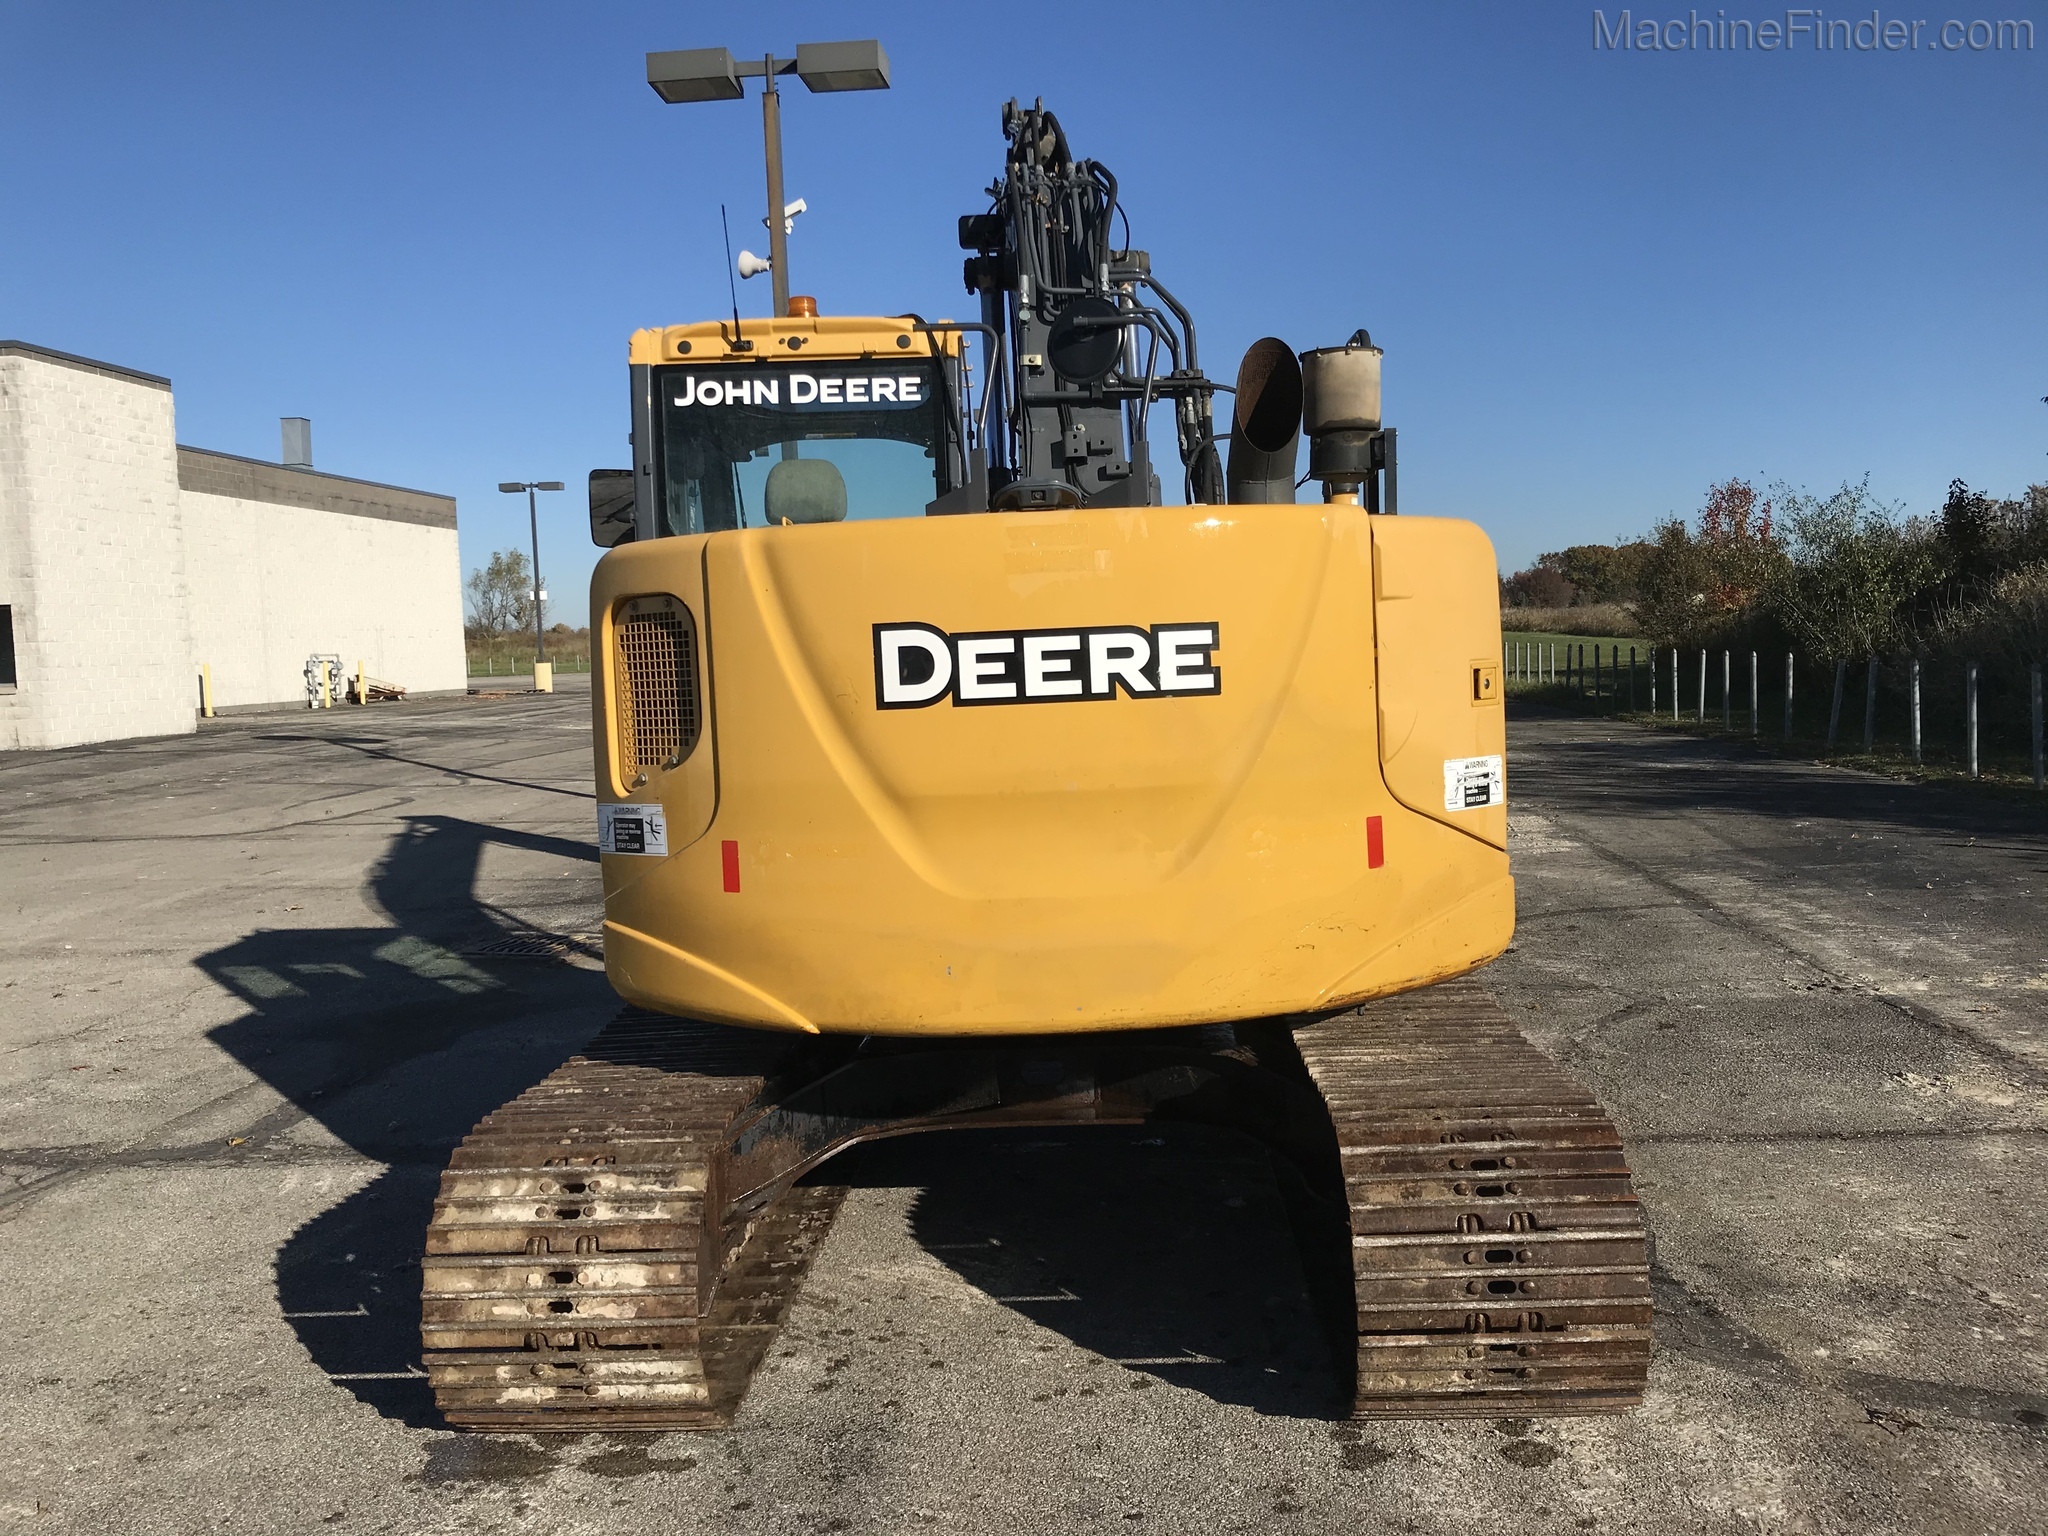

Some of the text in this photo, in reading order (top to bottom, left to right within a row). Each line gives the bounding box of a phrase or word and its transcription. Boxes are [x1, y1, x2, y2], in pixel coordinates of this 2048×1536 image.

[674, 374, 922, 407] JOHN DEERE
[877, 626, 1218, 705] DEERE
